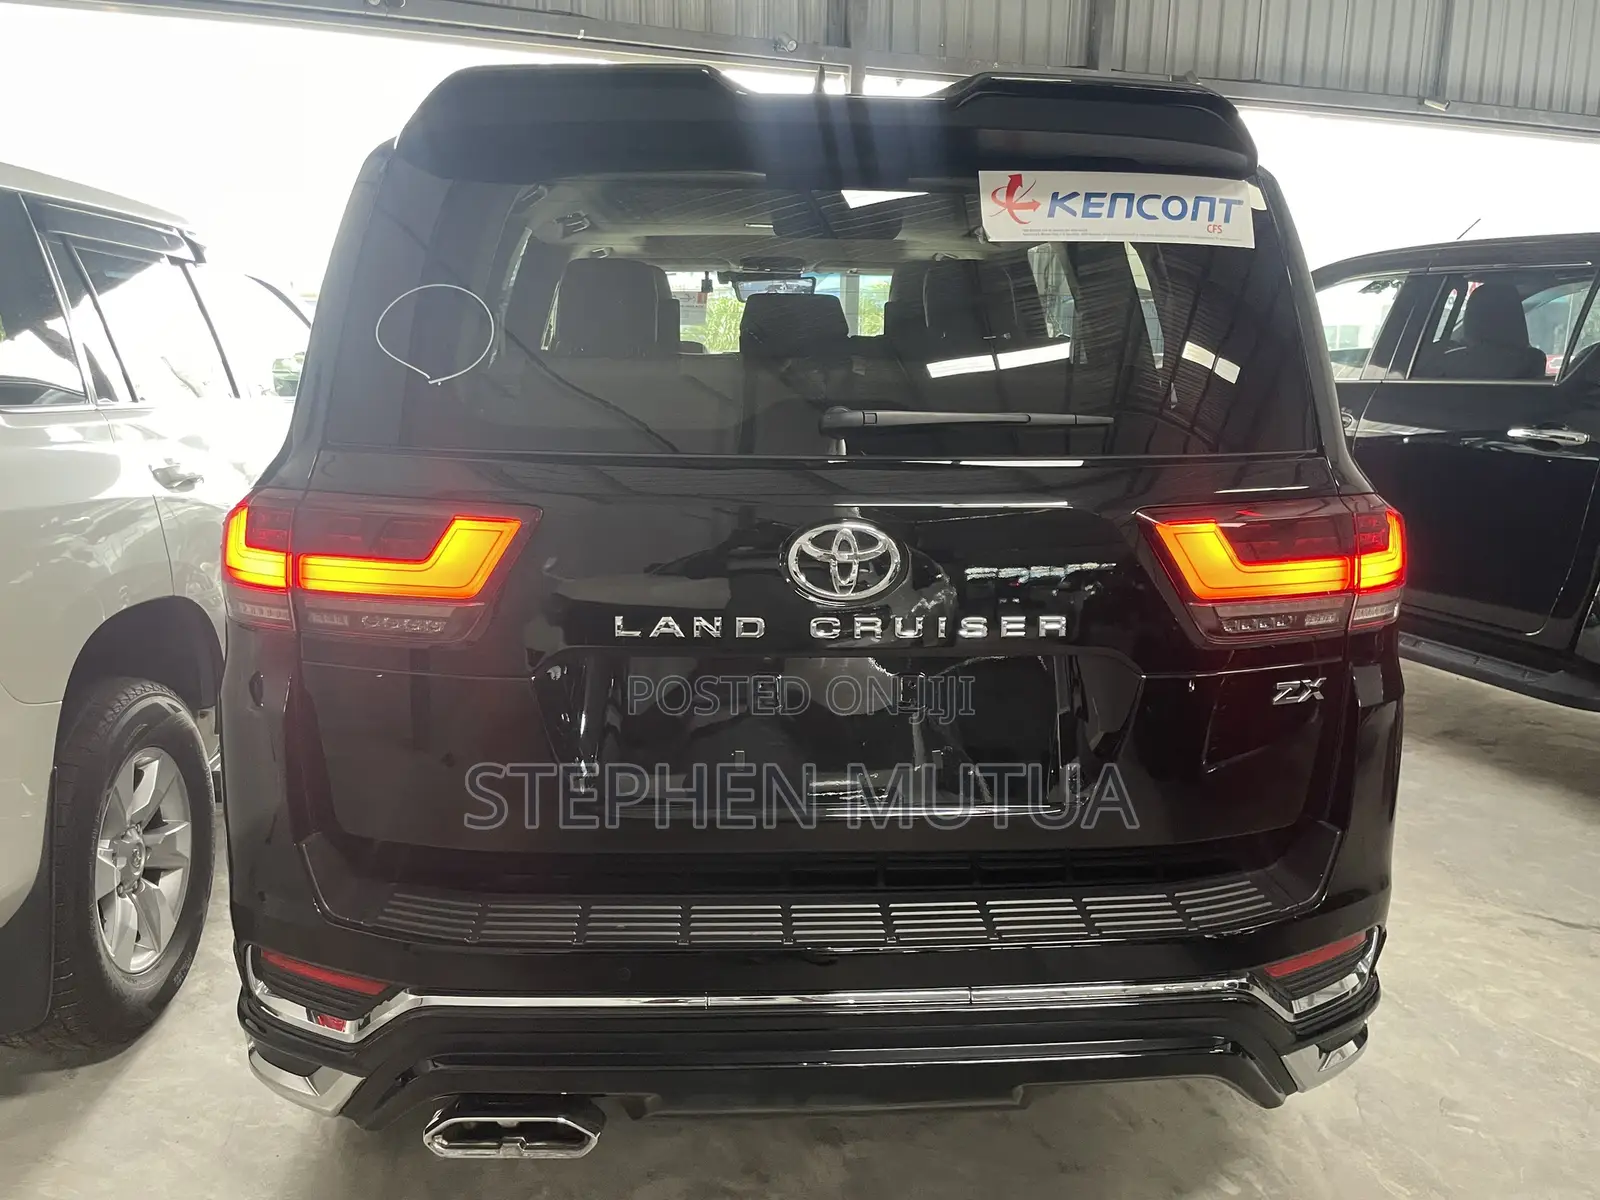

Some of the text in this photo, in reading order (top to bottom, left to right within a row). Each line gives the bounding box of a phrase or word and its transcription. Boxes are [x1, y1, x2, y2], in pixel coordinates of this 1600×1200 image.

[1206, 224, 1224, 234] CFS
[614, 615, 1067, 638] LAND CRUISER
[1272, 677, 1327, 705] ZX
